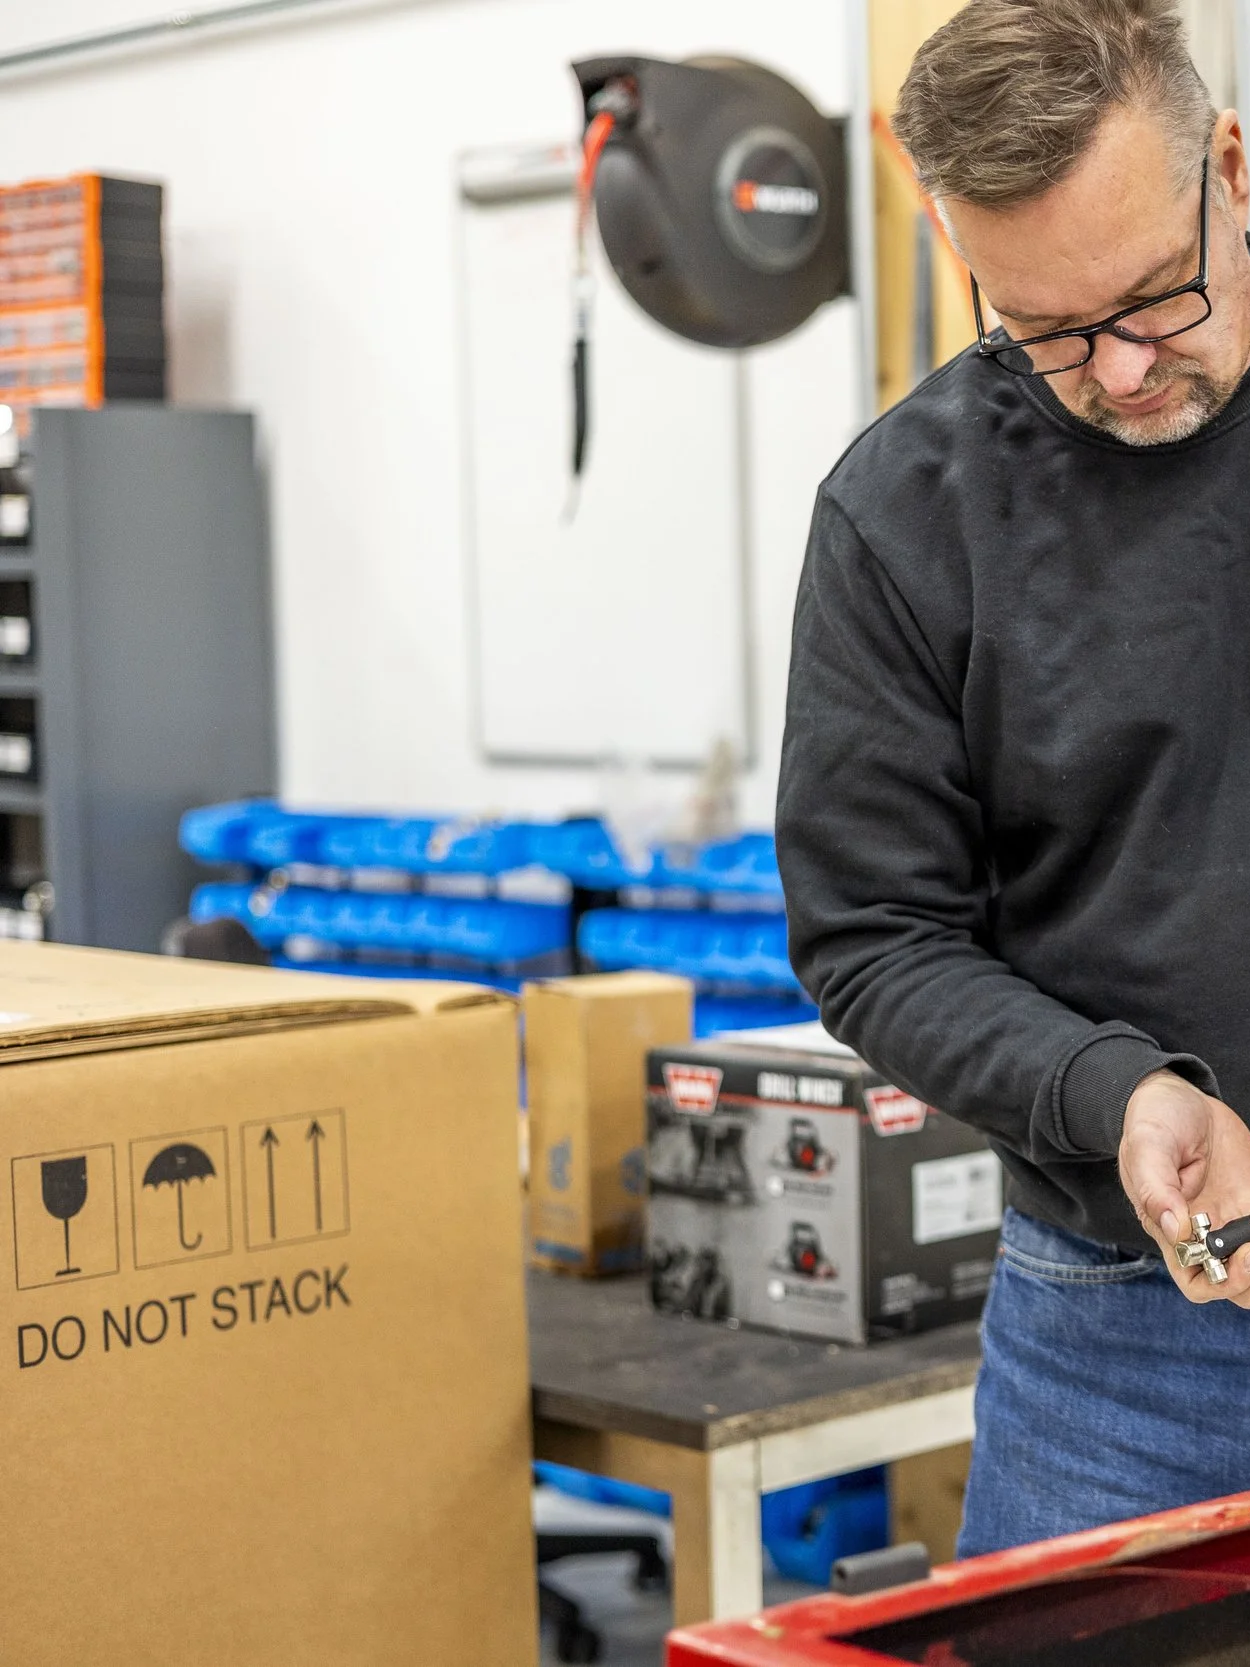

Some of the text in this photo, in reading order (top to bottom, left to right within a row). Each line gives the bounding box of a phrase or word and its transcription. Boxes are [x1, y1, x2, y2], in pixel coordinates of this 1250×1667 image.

[16, 1262, 352, 1369] DO NOT STACK
